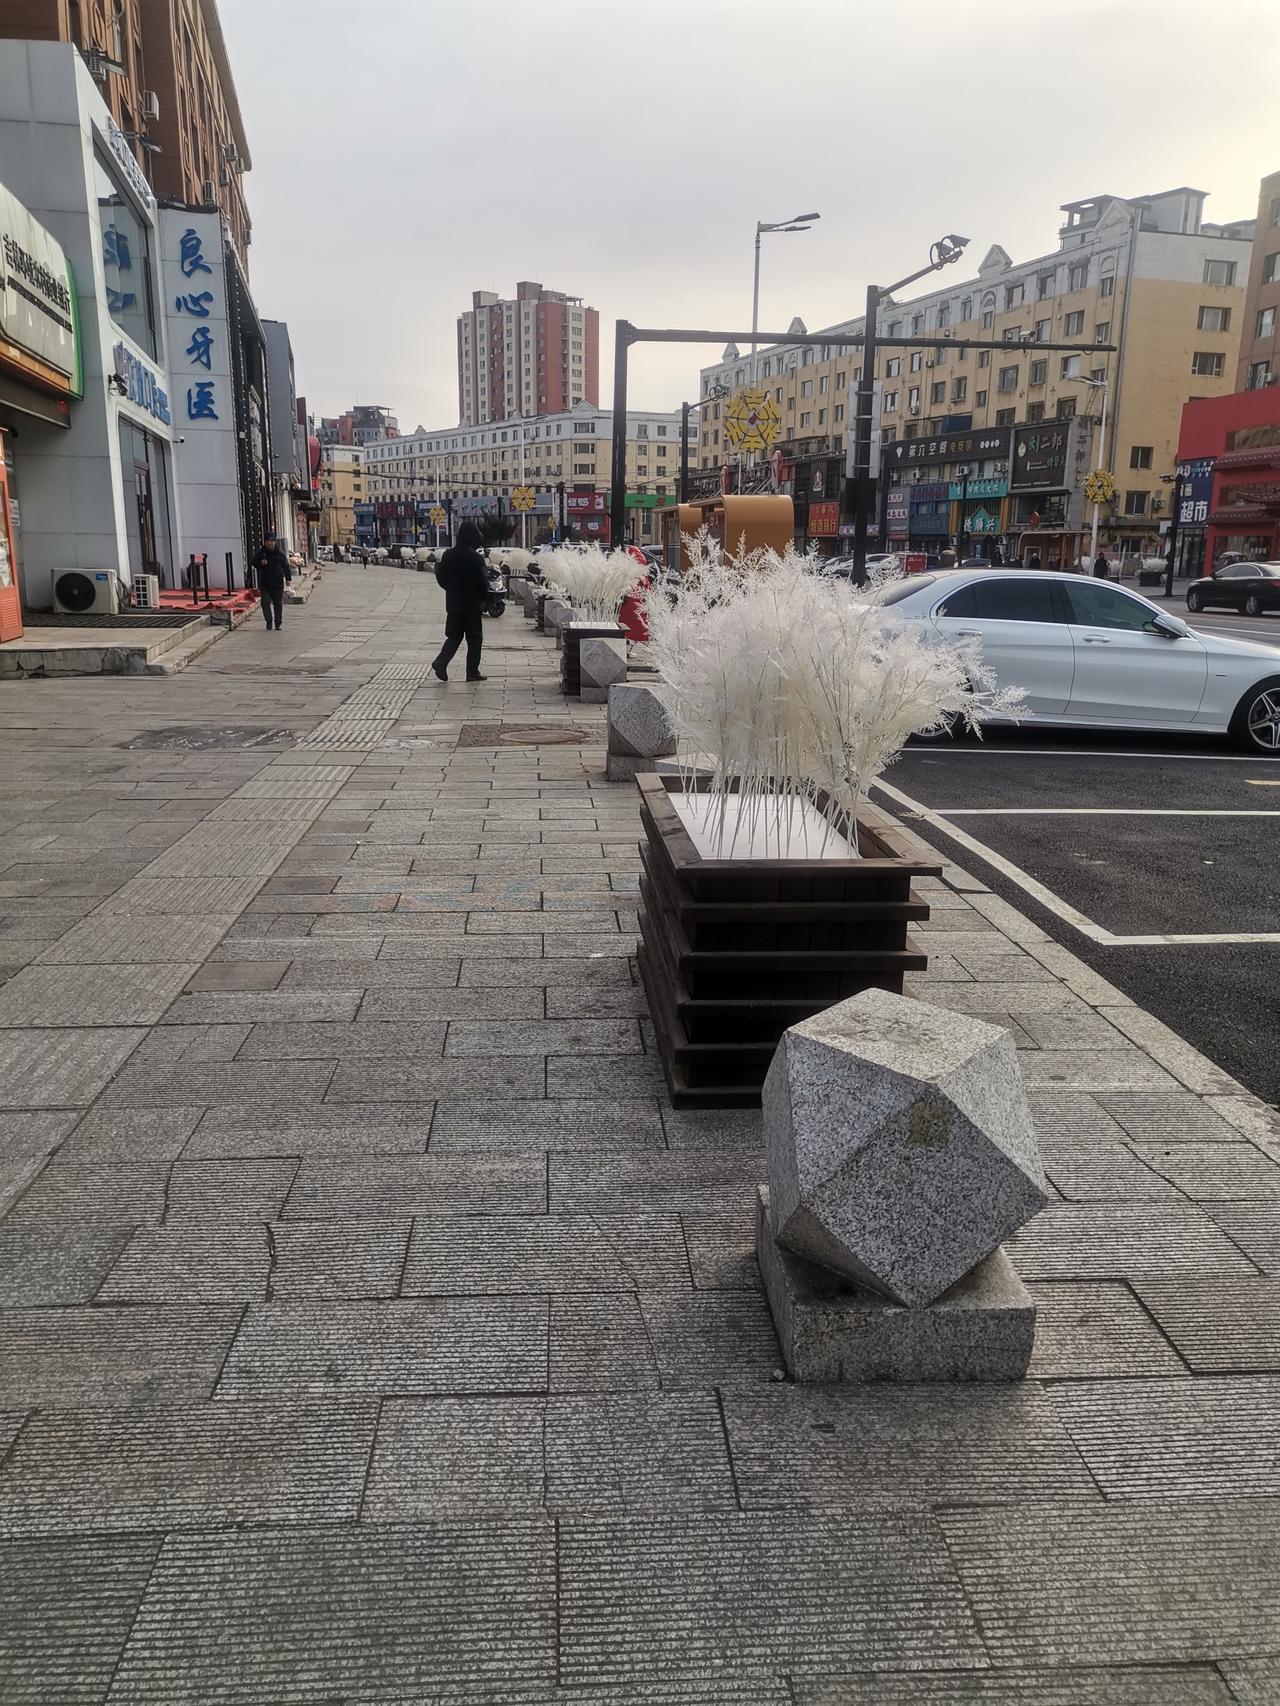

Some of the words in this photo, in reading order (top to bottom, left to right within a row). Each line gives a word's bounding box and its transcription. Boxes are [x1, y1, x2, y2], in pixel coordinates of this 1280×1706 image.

[176, 229, 219, 420] 良心牙医
[1179, 501, 1208, 522] 超市
